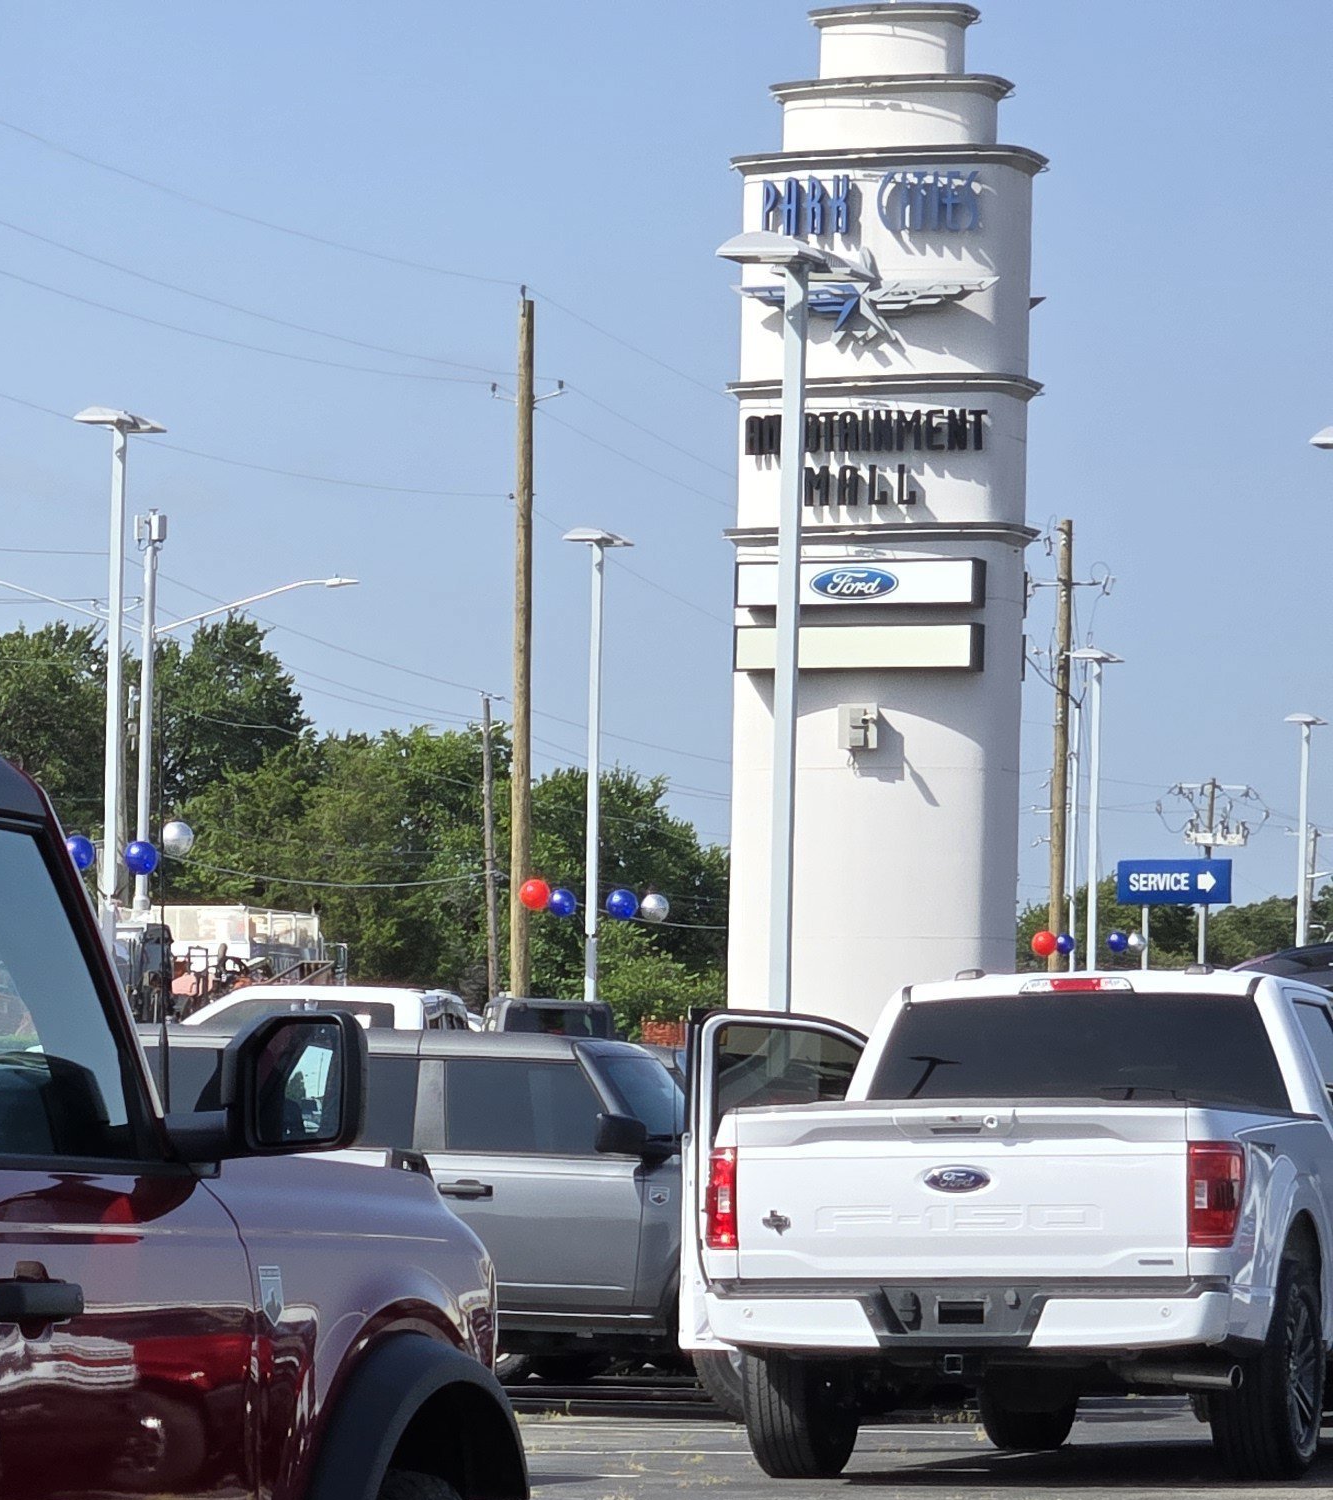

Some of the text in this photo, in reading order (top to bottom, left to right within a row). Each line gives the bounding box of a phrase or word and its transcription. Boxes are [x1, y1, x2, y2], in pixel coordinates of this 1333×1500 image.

[762, 170, 981, 236] PARK CITIES
[744, 409, 989, 456] AUOTAINMENT
[803, 463, 916, 507] MALL
[826, 571, 882, 595] Ford
[1129, 872, 1190, 892] SERVICE
[938, 1170, 976, 1188] Ford
[814, 1203, 1103, 1233] F-150
